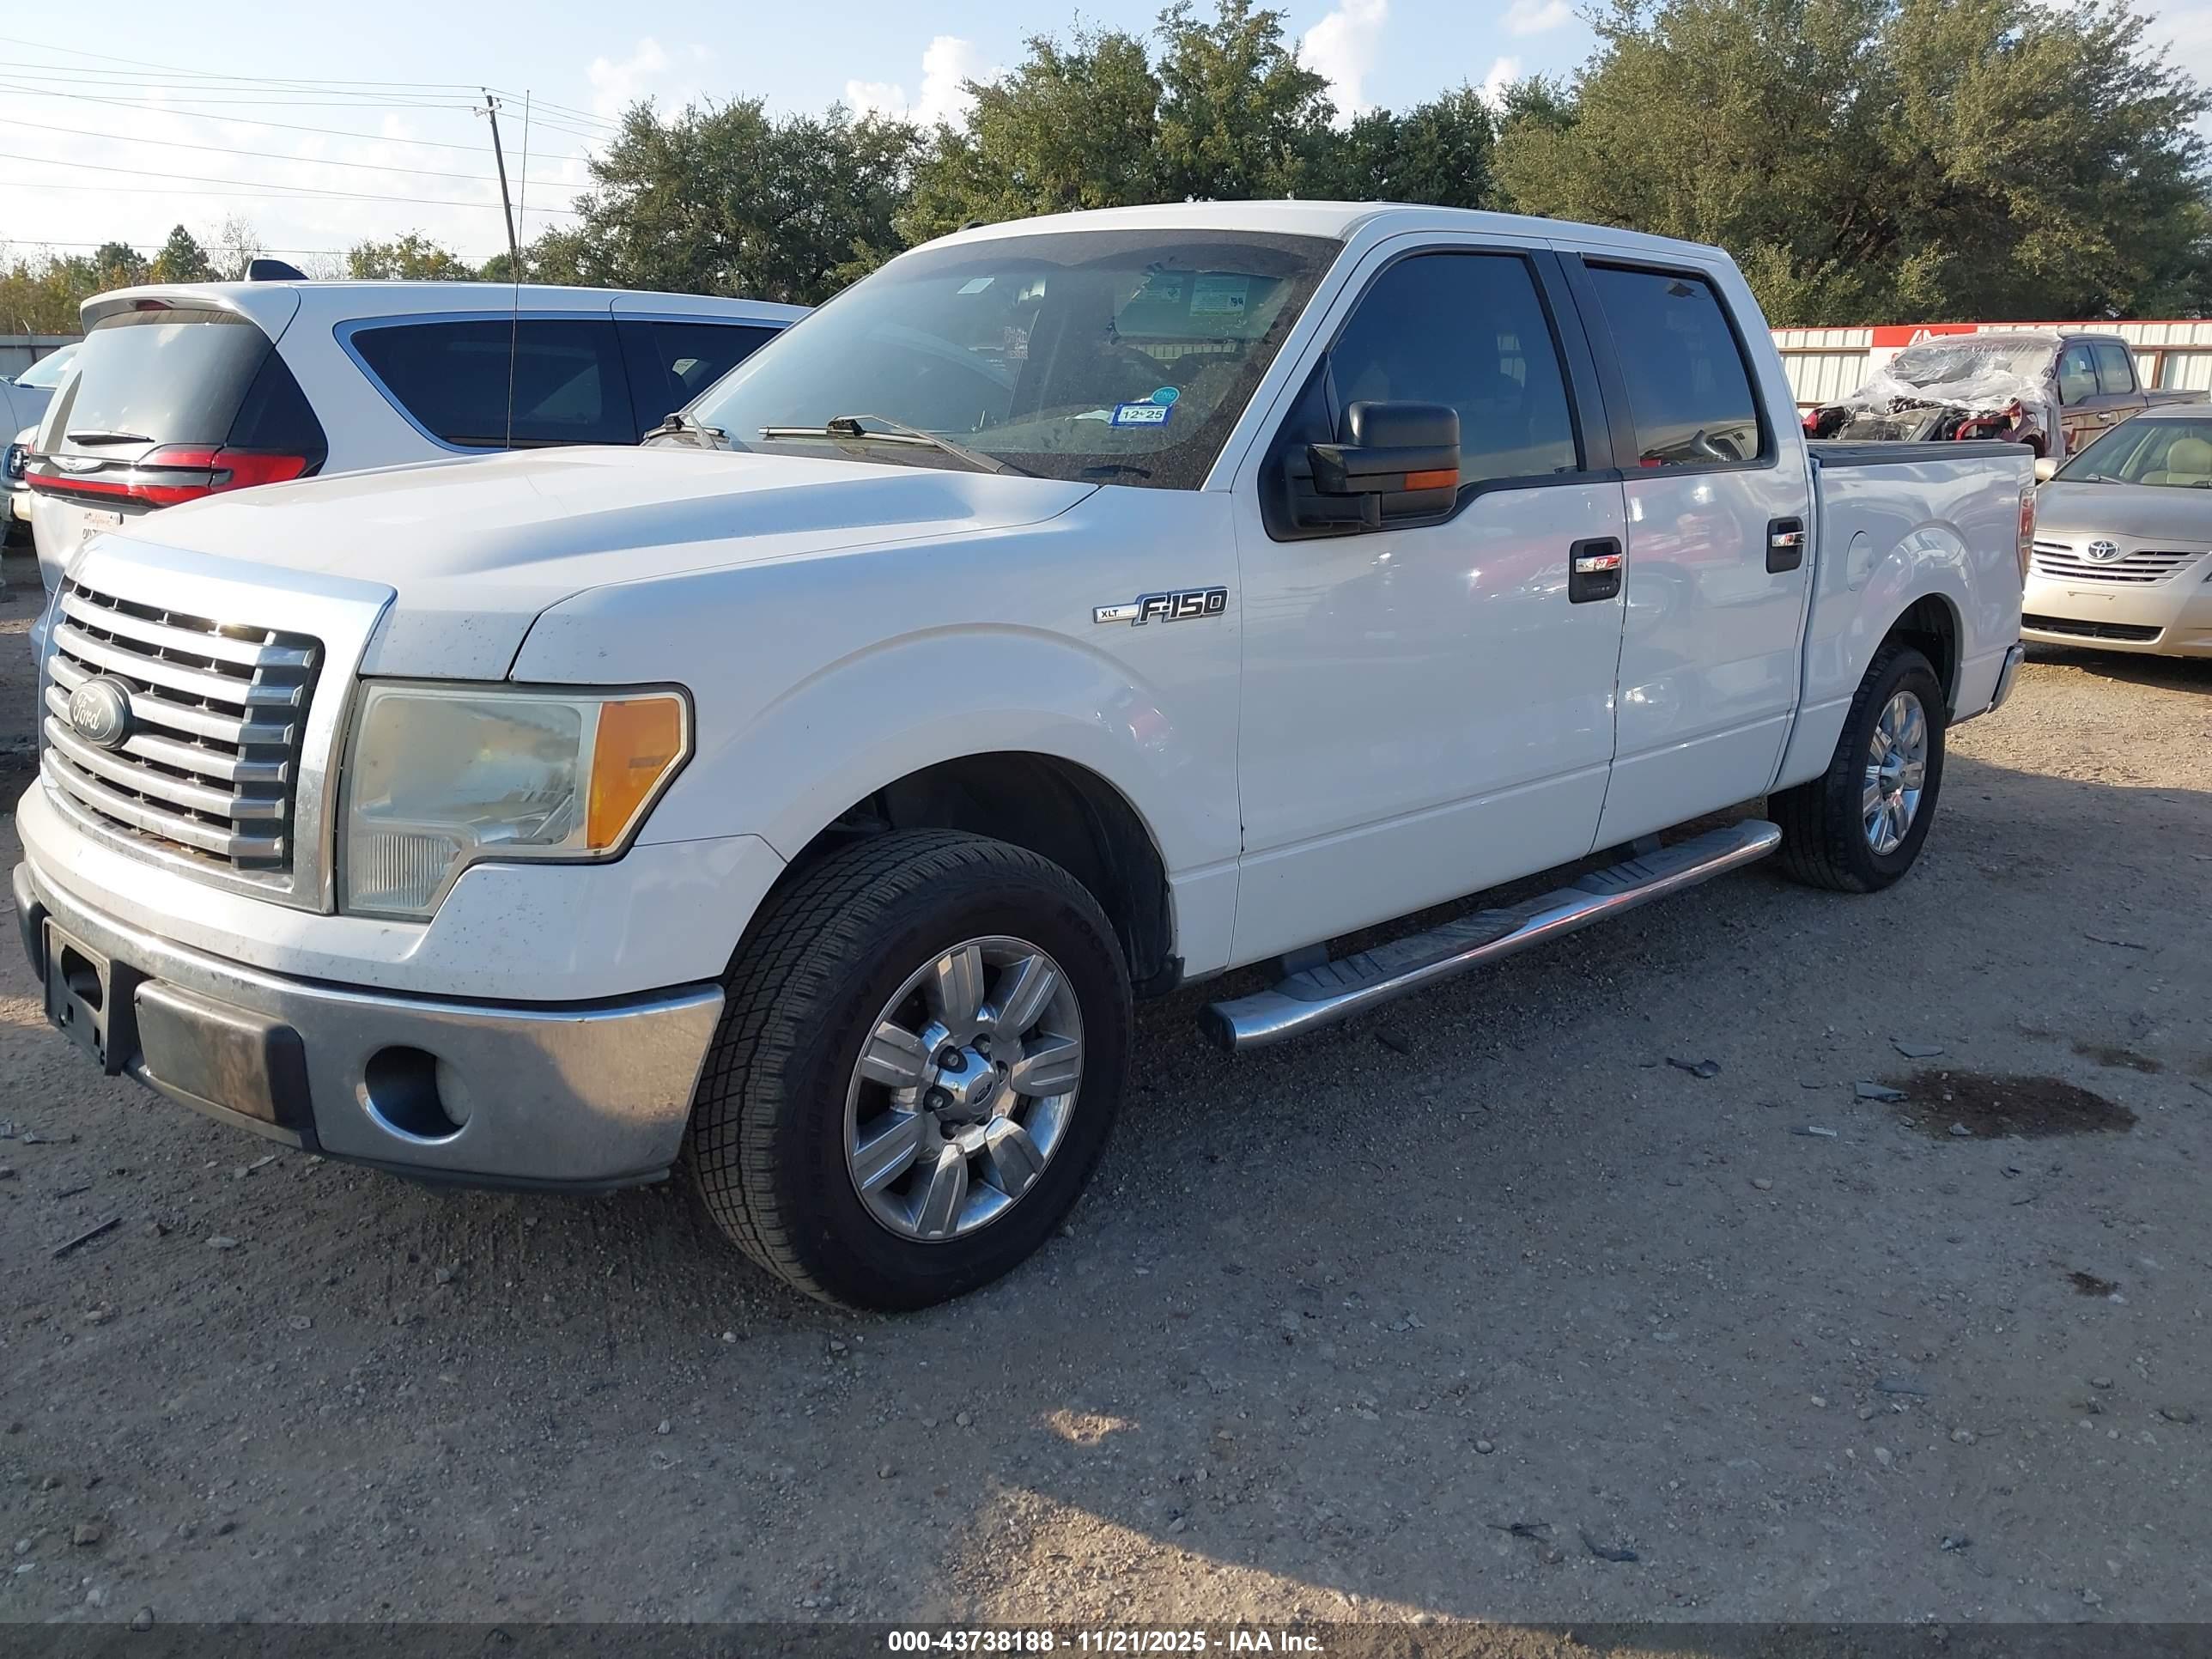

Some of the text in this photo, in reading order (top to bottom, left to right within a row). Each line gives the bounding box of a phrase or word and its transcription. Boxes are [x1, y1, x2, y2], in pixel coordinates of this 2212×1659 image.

[1101, 588, 1230, 623] XLT F-150
[73, 692, 102, 730] Ford
